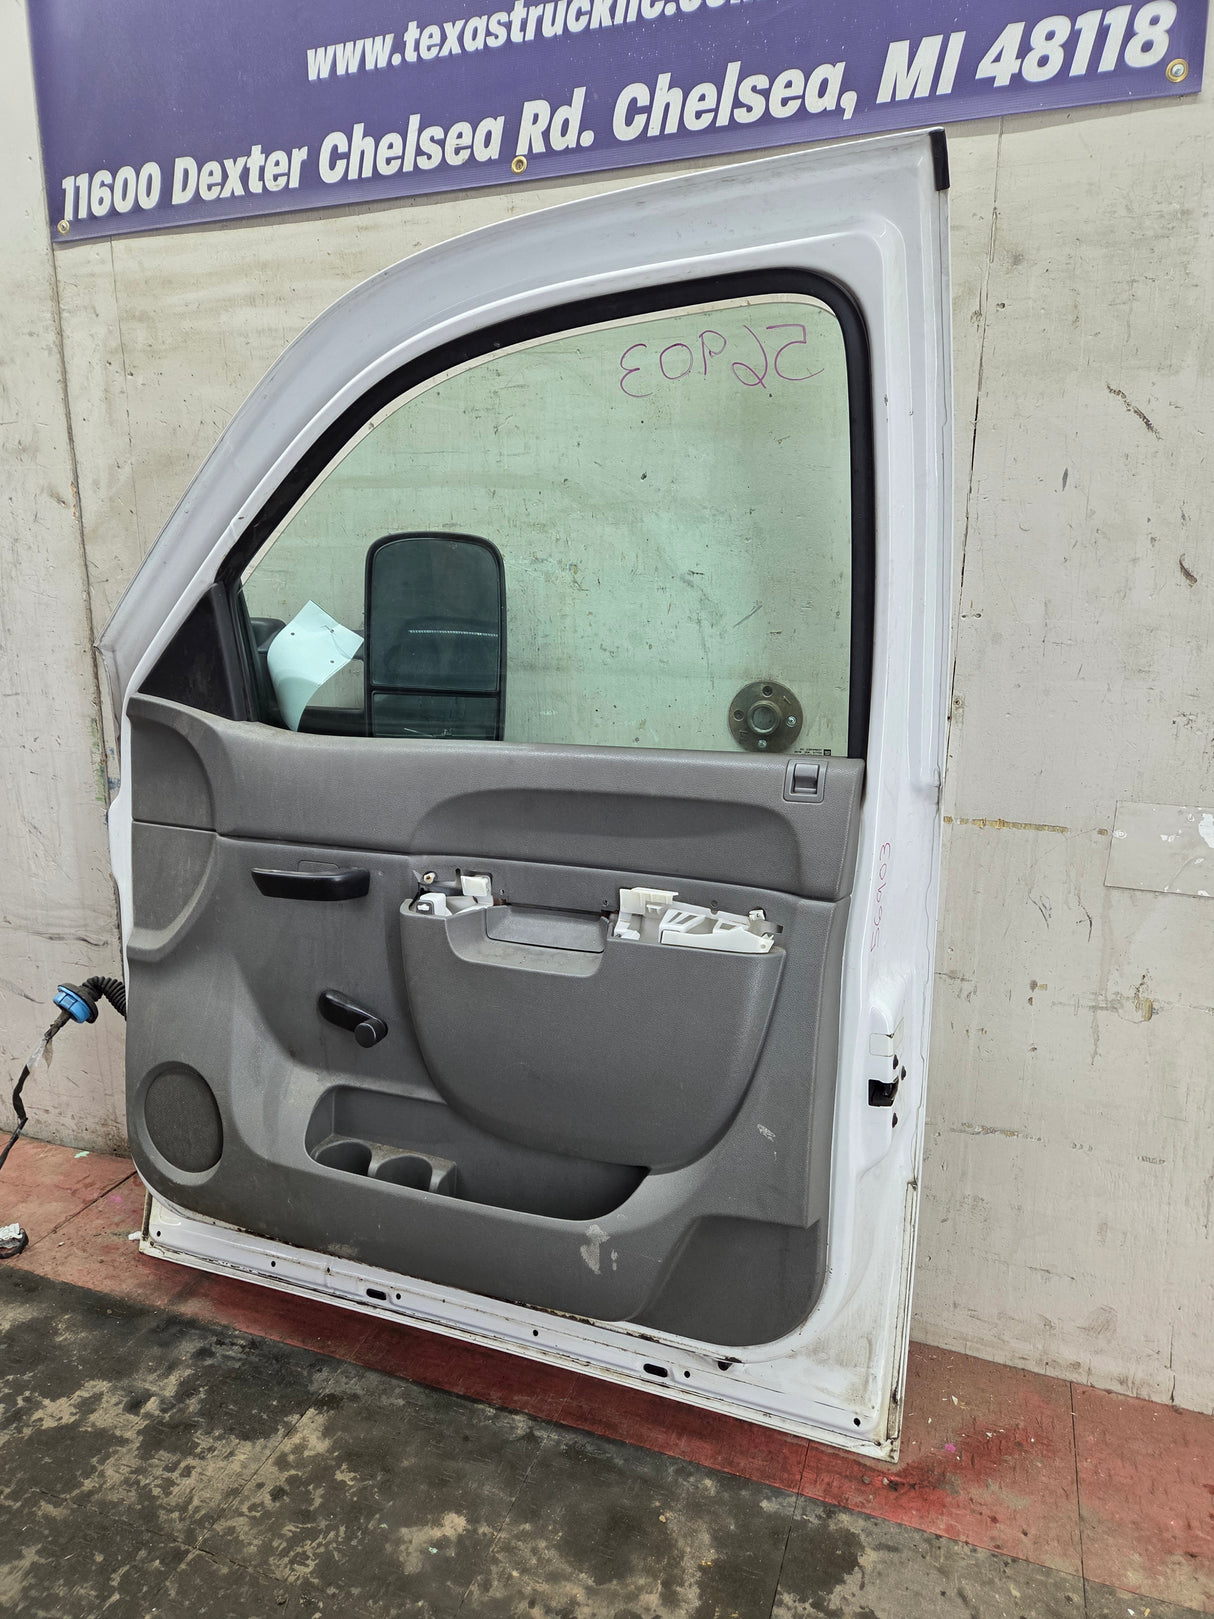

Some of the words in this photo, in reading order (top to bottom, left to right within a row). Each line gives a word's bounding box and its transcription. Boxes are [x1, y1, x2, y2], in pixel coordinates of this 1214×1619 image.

[61, 161, 162, 221] 11600
[171, 145, 308, 205] Dexter
[318, 114, 505, 184] Chelsea
[515, 87, 595, 157] Rd.
[612, 61, 858, 141] Chelsea,
[876, 31, 967, 104] MI
[975, 1, 1178, 88] 48118
[306, 0, 749, 81] www.texastruckllc.
